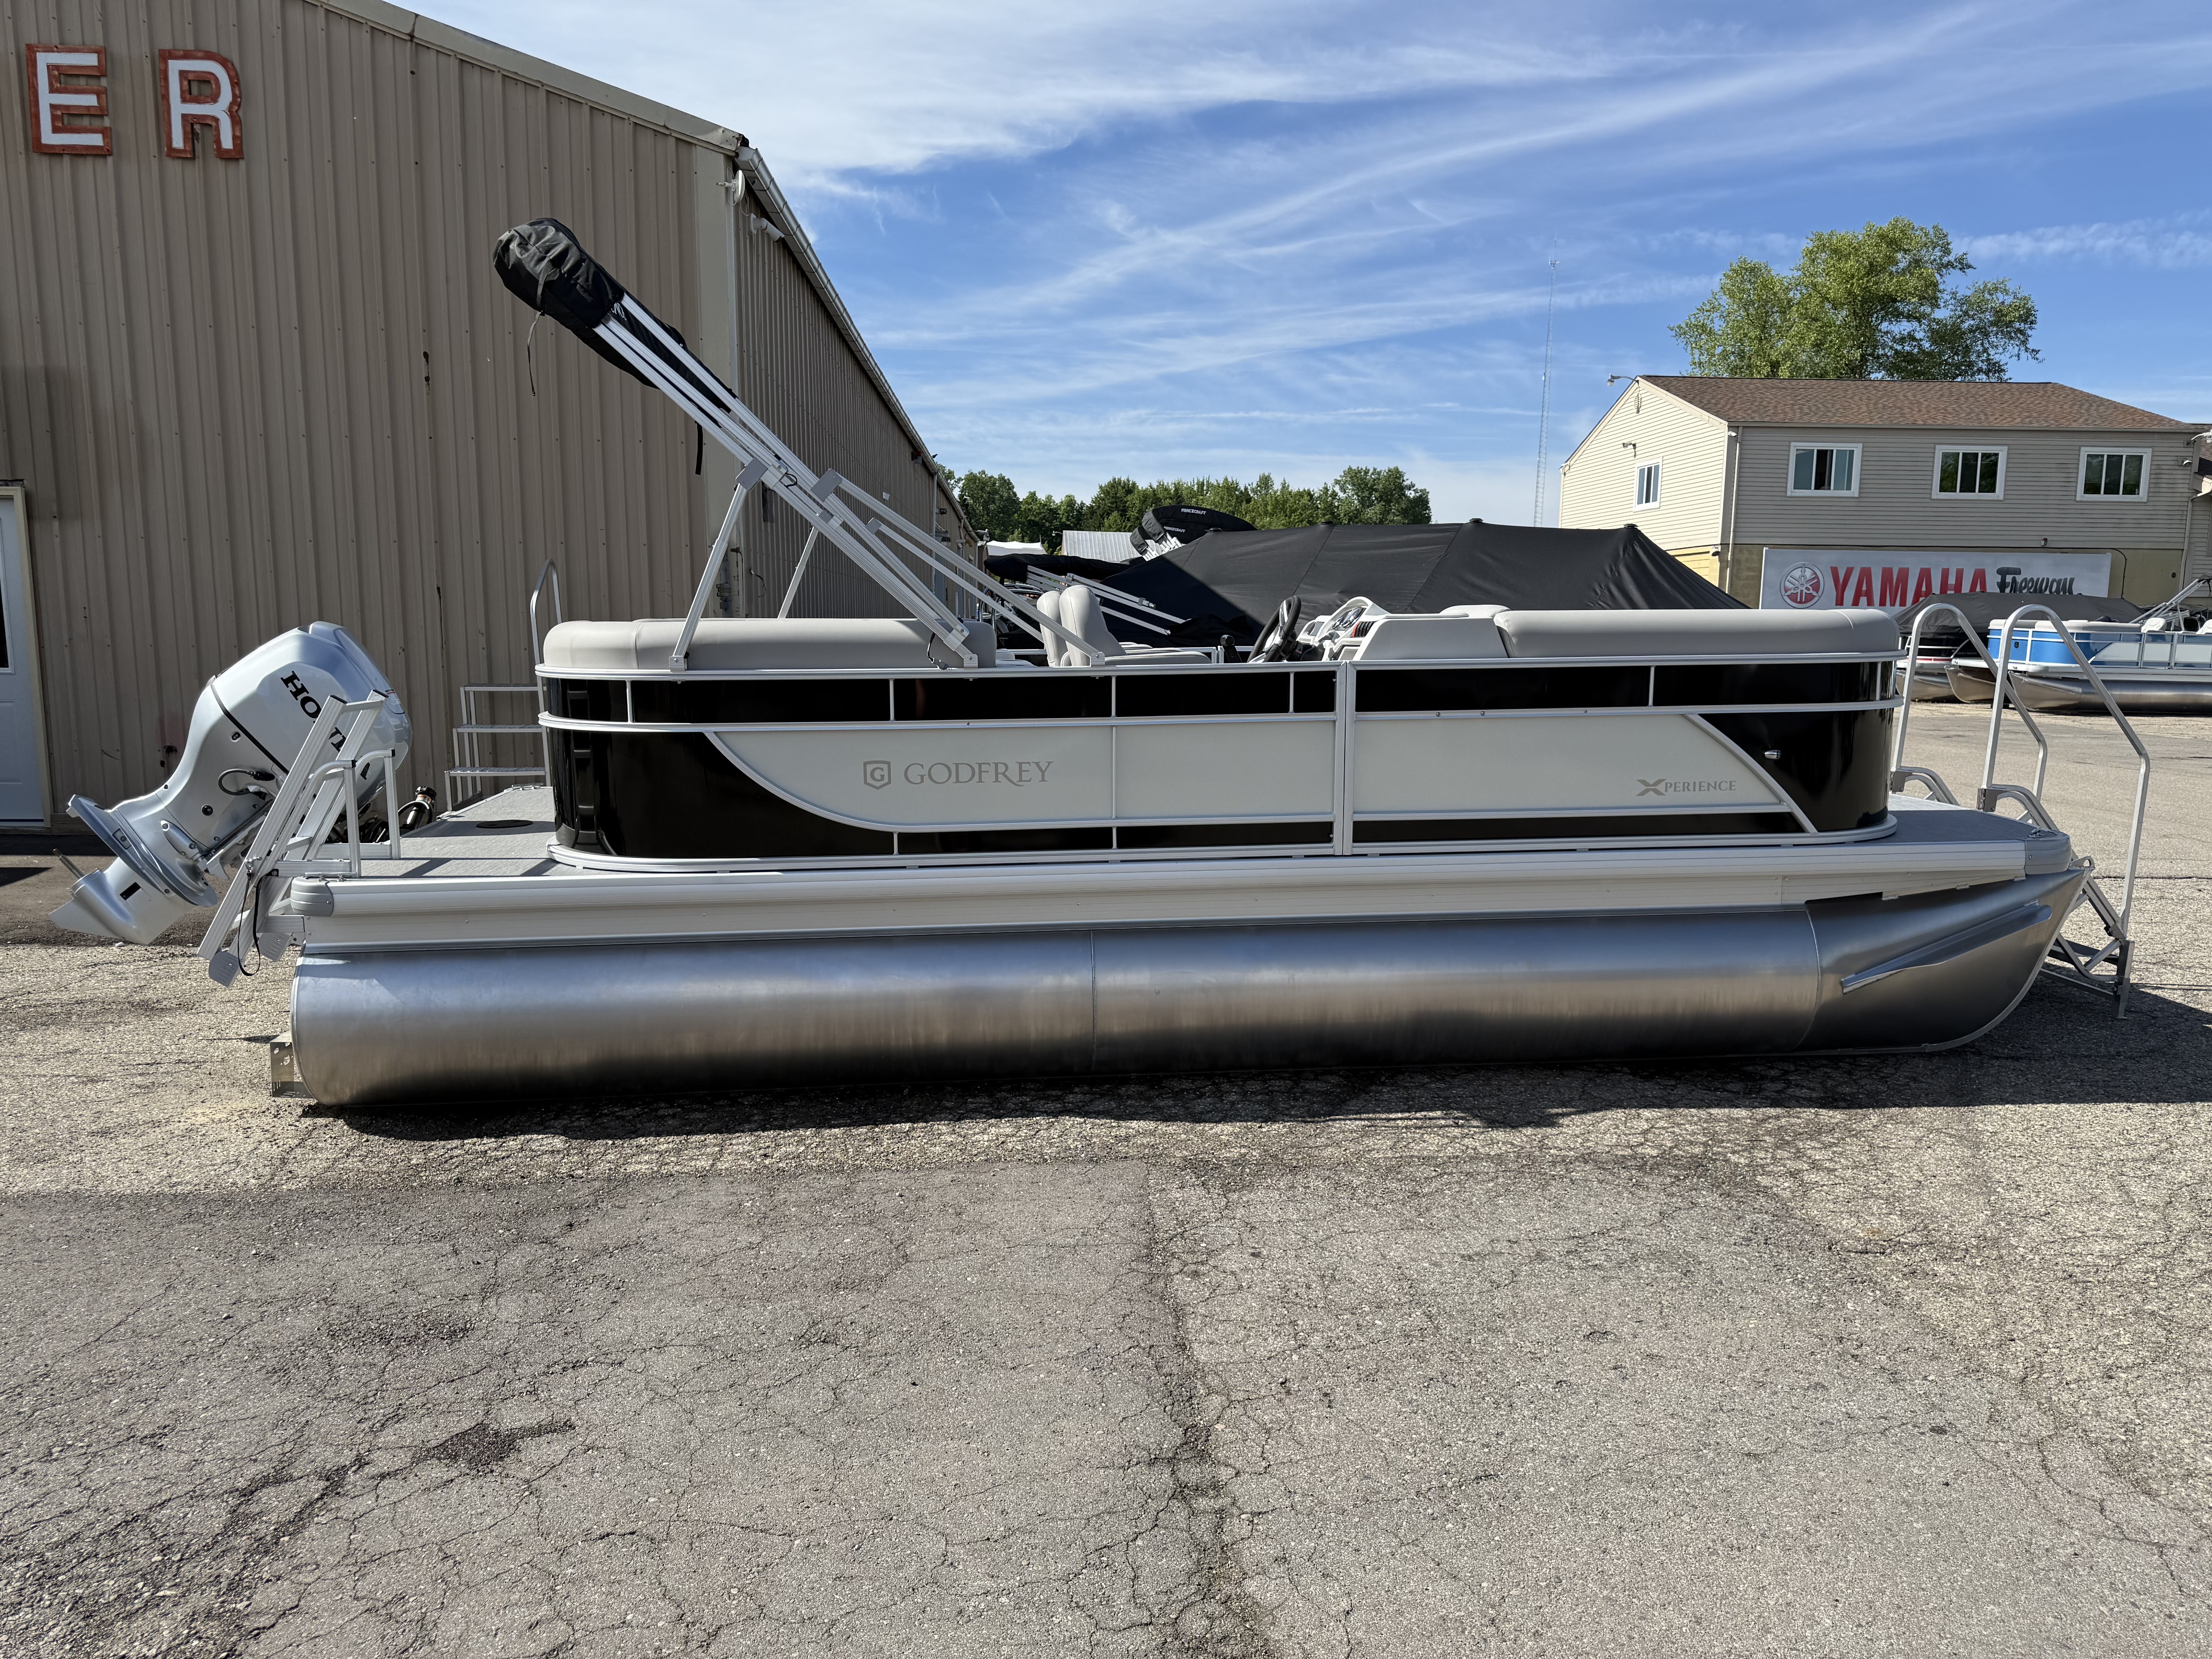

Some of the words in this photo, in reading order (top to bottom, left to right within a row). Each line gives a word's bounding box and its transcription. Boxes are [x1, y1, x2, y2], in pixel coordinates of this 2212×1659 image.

[1829, 566, 1987, 607] YAMAHA
[903, 761, 1054, 787] GODFREY
[1635, 778, 1736, 797] XPERIENCE
